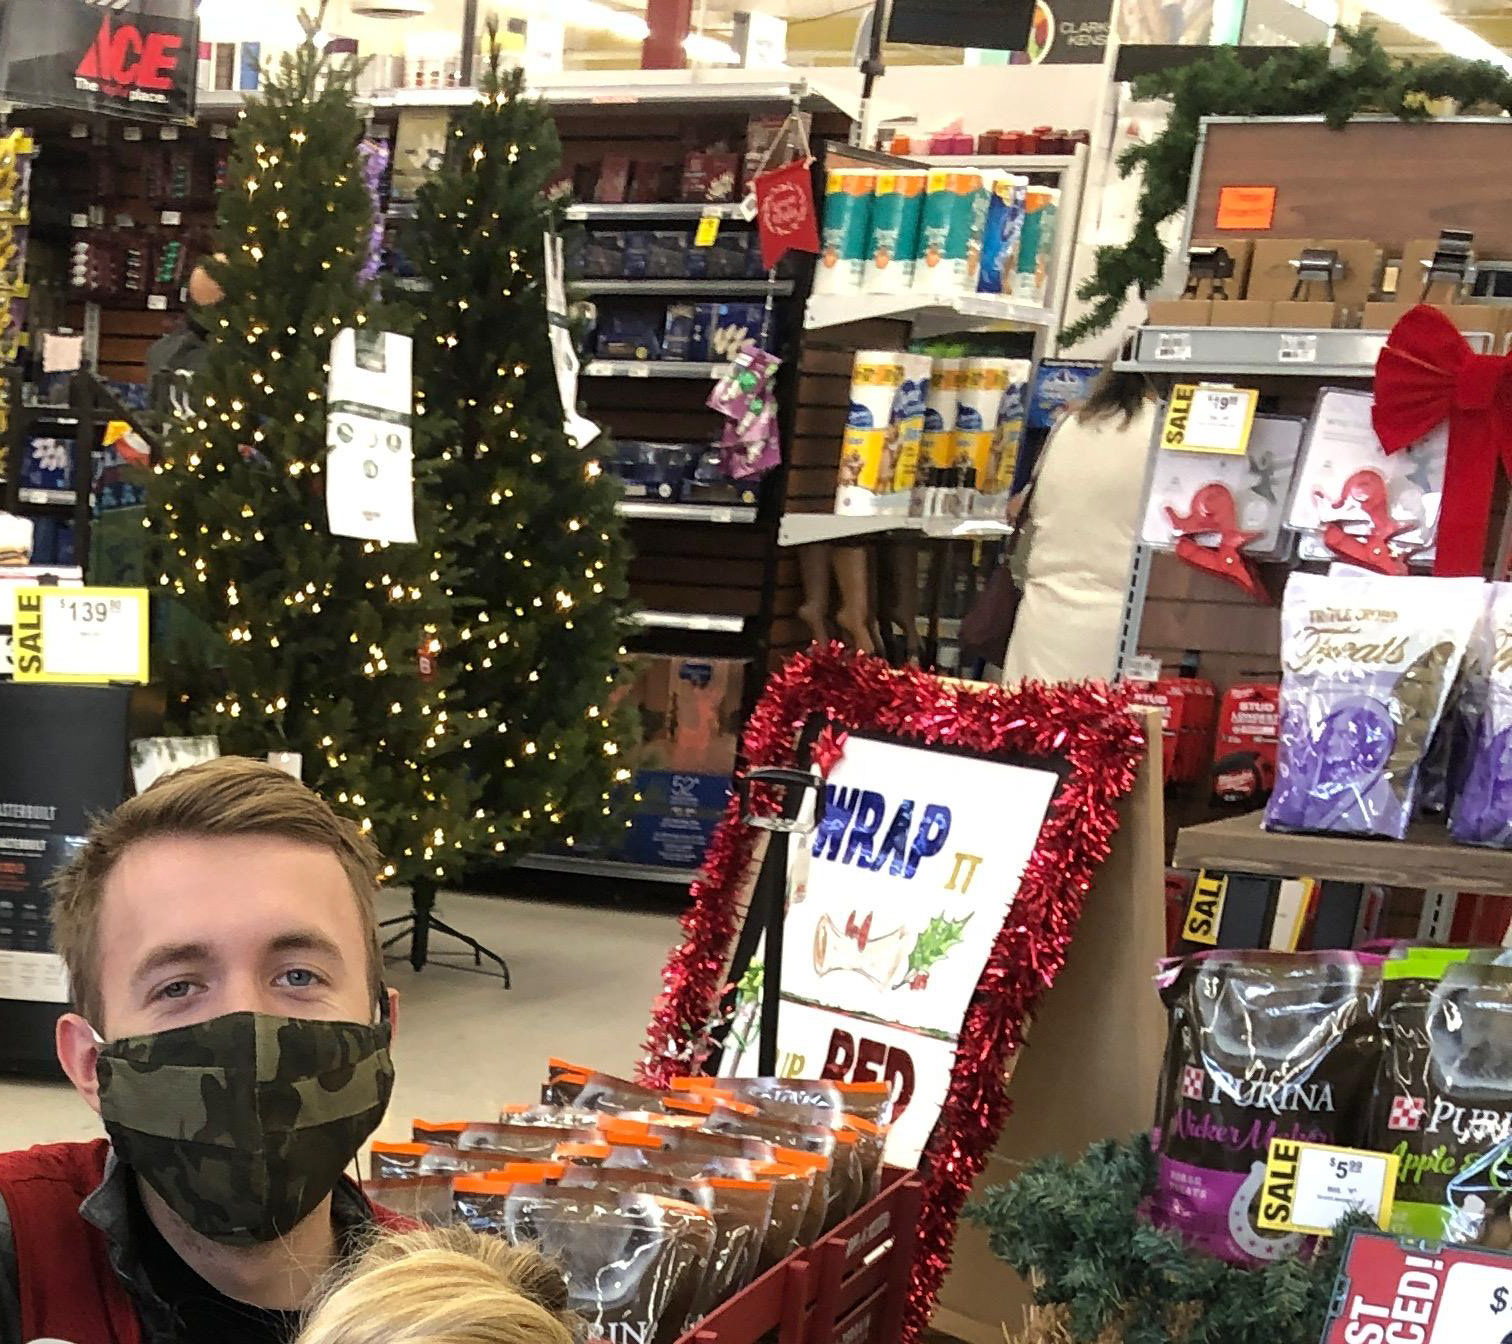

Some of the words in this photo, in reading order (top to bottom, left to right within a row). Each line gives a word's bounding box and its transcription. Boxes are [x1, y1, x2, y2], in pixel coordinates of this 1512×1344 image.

[75, 11, 183, 90] ACE
[1166, 387, 1195, 444] SALE
[18, 594, 42, 675] SALE
[811, 783, 952, 880] WRAP
[944, 852, 984, 894] IT
[1189, 883, 1222, 937] SAL
[1264, 1143, 1301, 1224] SALE
[1391, 1140, 1457, 1184] Apple
